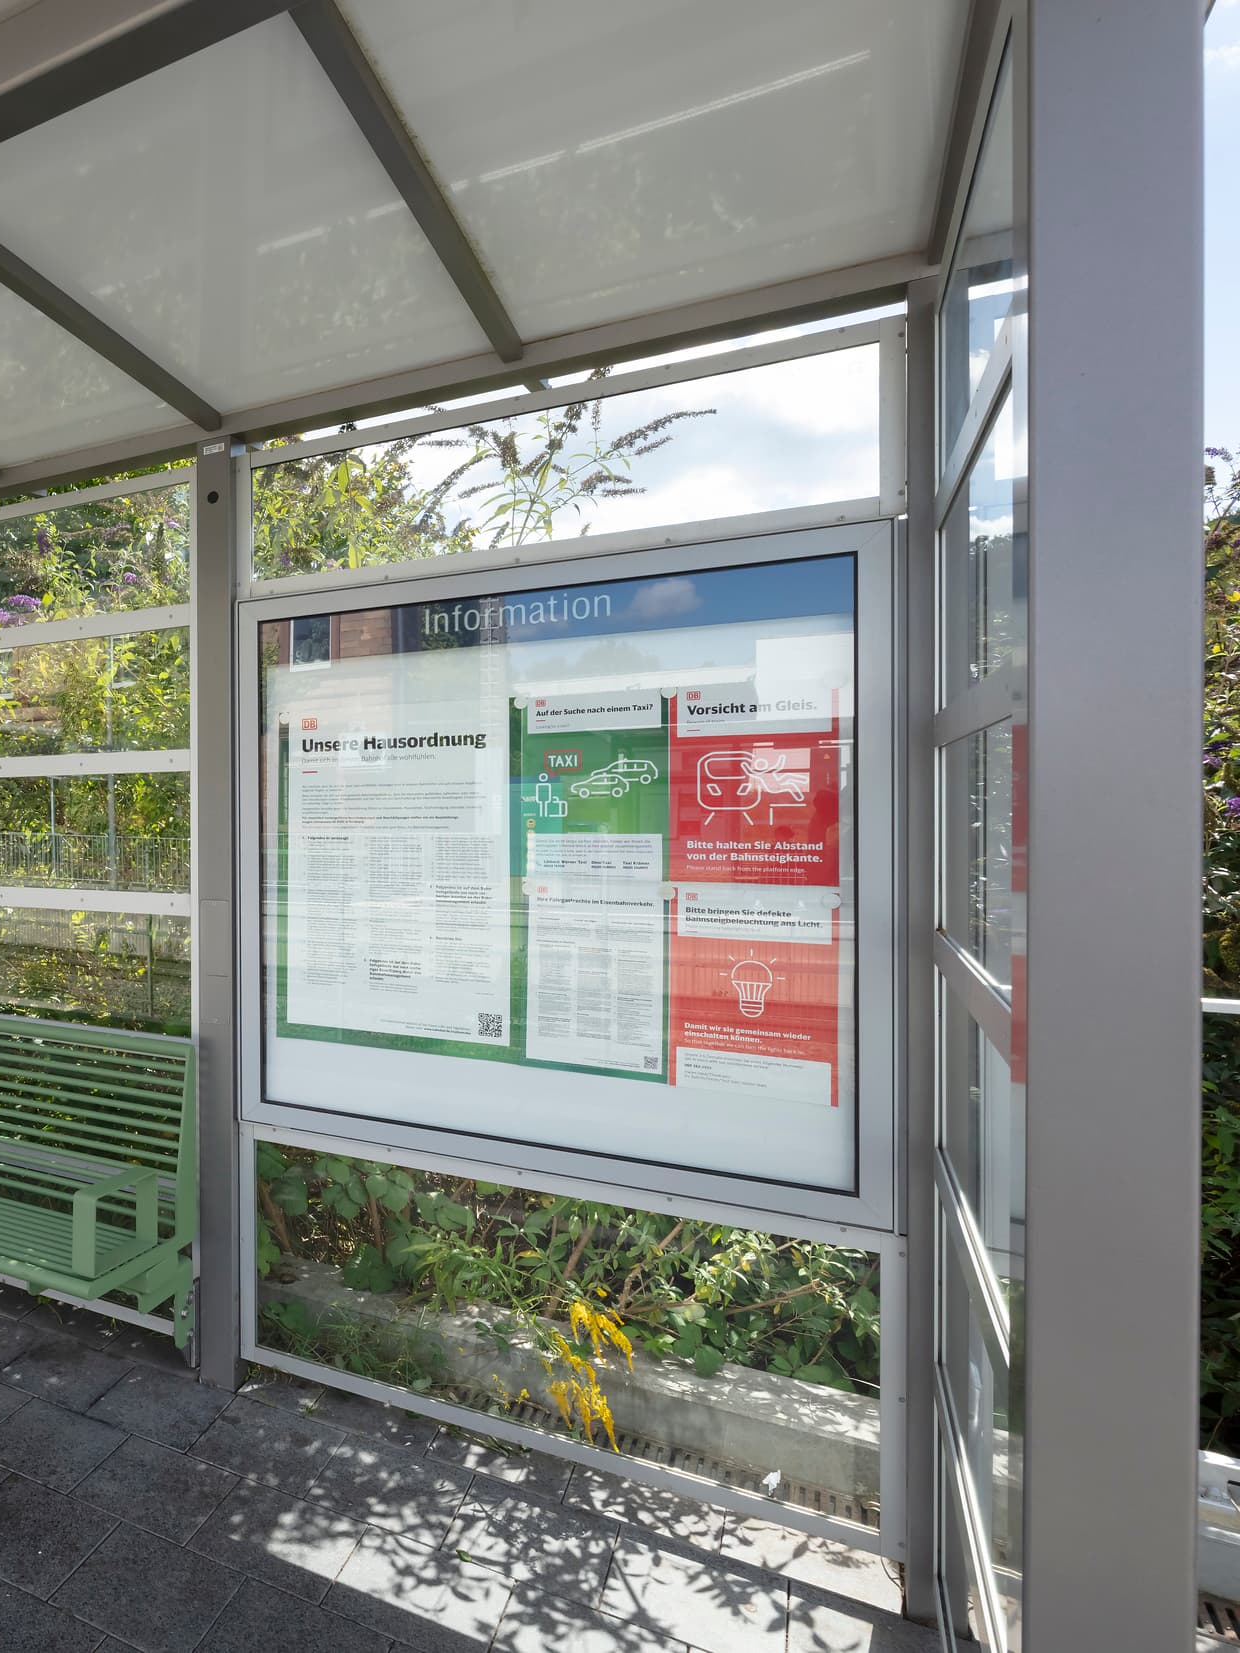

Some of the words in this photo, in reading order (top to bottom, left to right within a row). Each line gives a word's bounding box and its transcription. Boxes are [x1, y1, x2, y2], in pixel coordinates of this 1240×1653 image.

[424, 592, 611, 635] Information
[687, 691, 700, 700] DB
[536, 709, 550, 717] Auf
[587, 706, 606, 714] nach
[607, 705, 631, 713] einem
[632, 703, 654, 711] Taxi?
[688, 703, 746, 716] Vorsicht
[749, 702, 771, 713] am
[775, 699, 817, 712] Gleis.
[302, 718, 317, 730] DB
[302, 738, 364, 752] Unsere
[364, 732, 487, 750] Hausordnung
[548, 754, 578, 767] TAXI
[687, 840, 714, 849] Bitte
[716, 840, 753, 849] halten
[754, 841, 771, 850] Sie
[774, 842, 824, 851] Abstand
[686, 853, 706, 861] von
[709, 853, 728, 861] der
[730, 852, 823, 864] Bahnsteigkante.
[686, 906, 706, 914] Bitte
[707, 907, 740, 917] bringen
[780, 920, 796, 928] ans
[798, 920, 823, 929] Licht.
[684, 1022, 708, 1032] Damit
[722, 1025, 734, 1034] sie
[736, 1027, 781, 1039] gemeinsam
[783, 1032, 812, 1041] wieder
[684, 1030, 730, 1041] einschalten
[730, 1031, 763, 1044] können.
